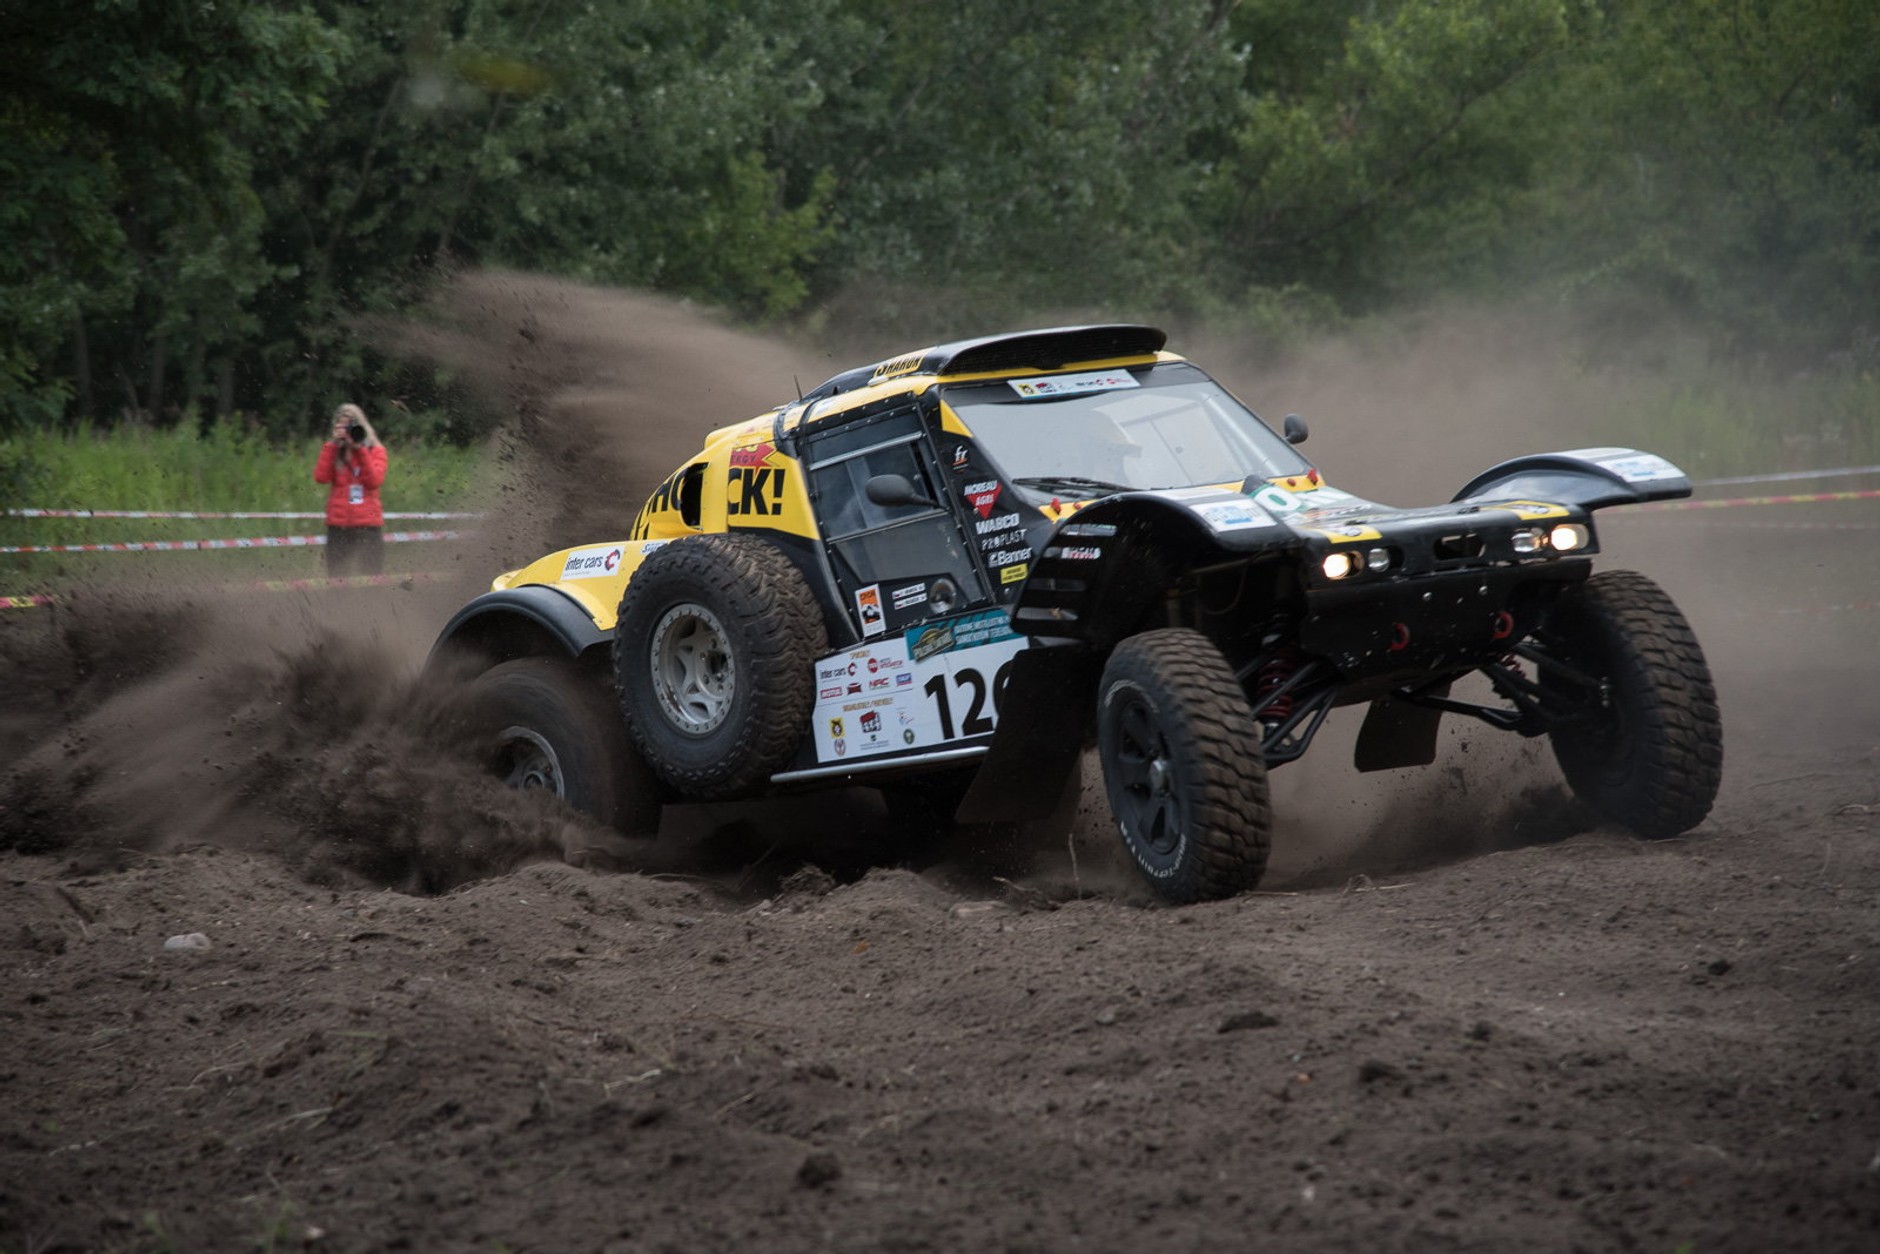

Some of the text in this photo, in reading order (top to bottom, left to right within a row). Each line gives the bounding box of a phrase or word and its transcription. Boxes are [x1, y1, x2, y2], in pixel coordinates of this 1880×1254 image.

[975, 512, 1020, 535] WABCO
[565, 556, 603, 572] inter cars
[997, 547, 1033, 566] Banner
